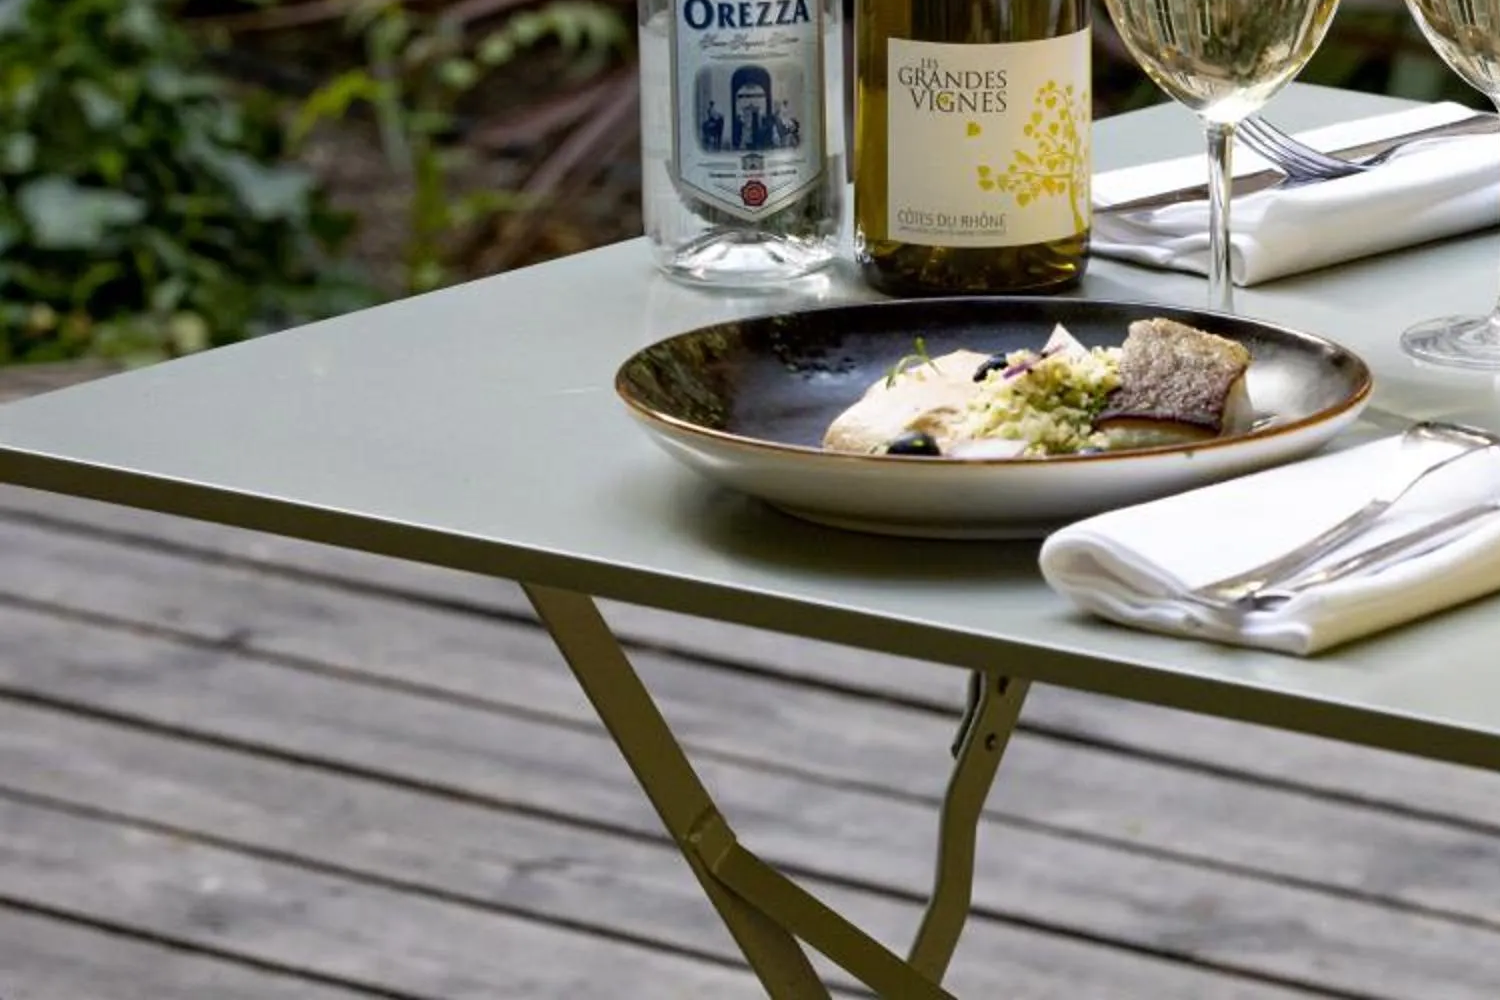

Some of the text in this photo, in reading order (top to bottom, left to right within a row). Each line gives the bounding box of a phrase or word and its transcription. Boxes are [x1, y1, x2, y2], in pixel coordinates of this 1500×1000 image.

[897, 65, 1008, 91] GRANDES
[910, 88, 1008, 113] VIGNES
[937, 211, 958, 228] DU
